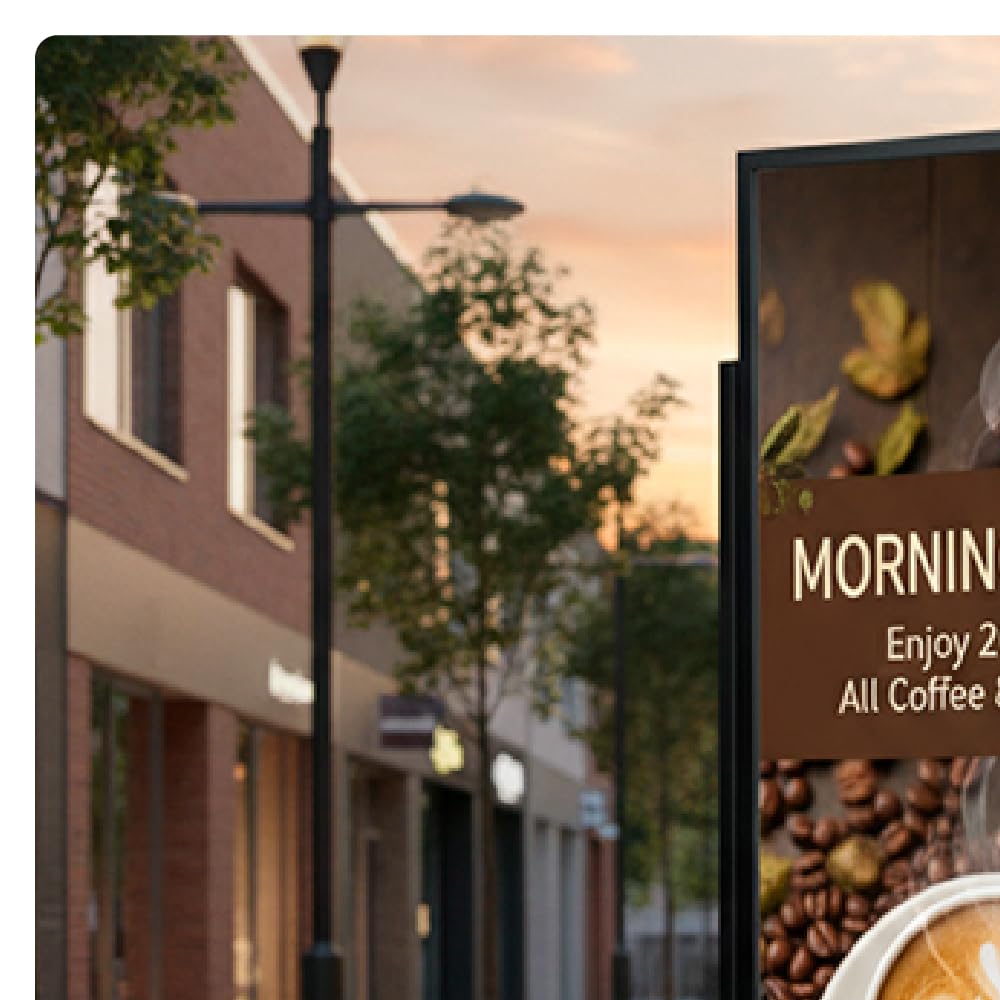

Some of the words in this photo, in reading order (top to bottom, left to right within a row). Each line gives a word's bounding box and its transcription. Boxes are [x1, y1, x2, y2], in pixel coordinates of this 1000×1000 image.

[888, 627, 969, 670] Enjoy
[839, 678, 879, 713] All
[888, 676, 986, 713] Coffee
